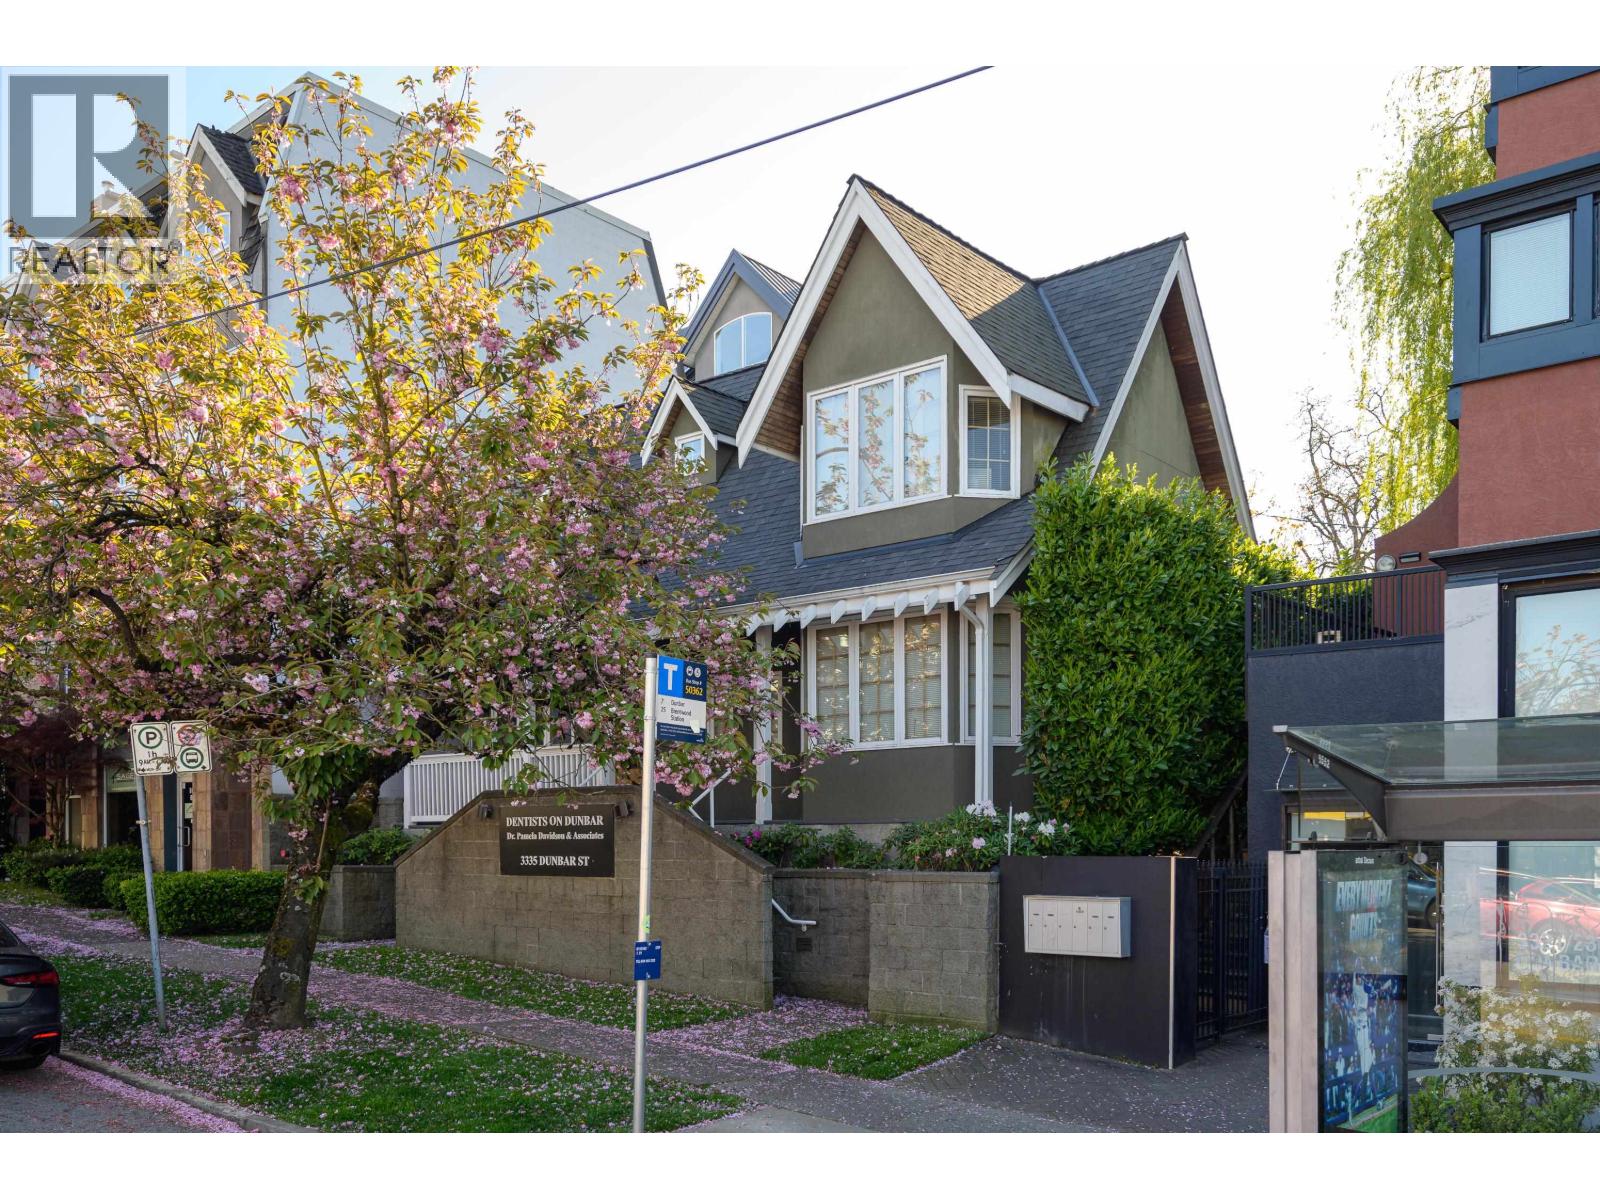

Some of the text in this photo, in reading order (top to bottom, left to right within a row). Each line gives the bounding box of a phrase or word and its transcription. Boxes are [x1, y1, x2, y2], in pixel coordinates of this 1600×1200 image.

[686, 686, 703, 695] 50362
[506, 815, 604, 827] DENTISTS ON DUNBAR
[506, 831, 604, 840] Dr. Pamela Davidson & Associates
[520, 855, 590, 867] 3335 DUNBAR ST
